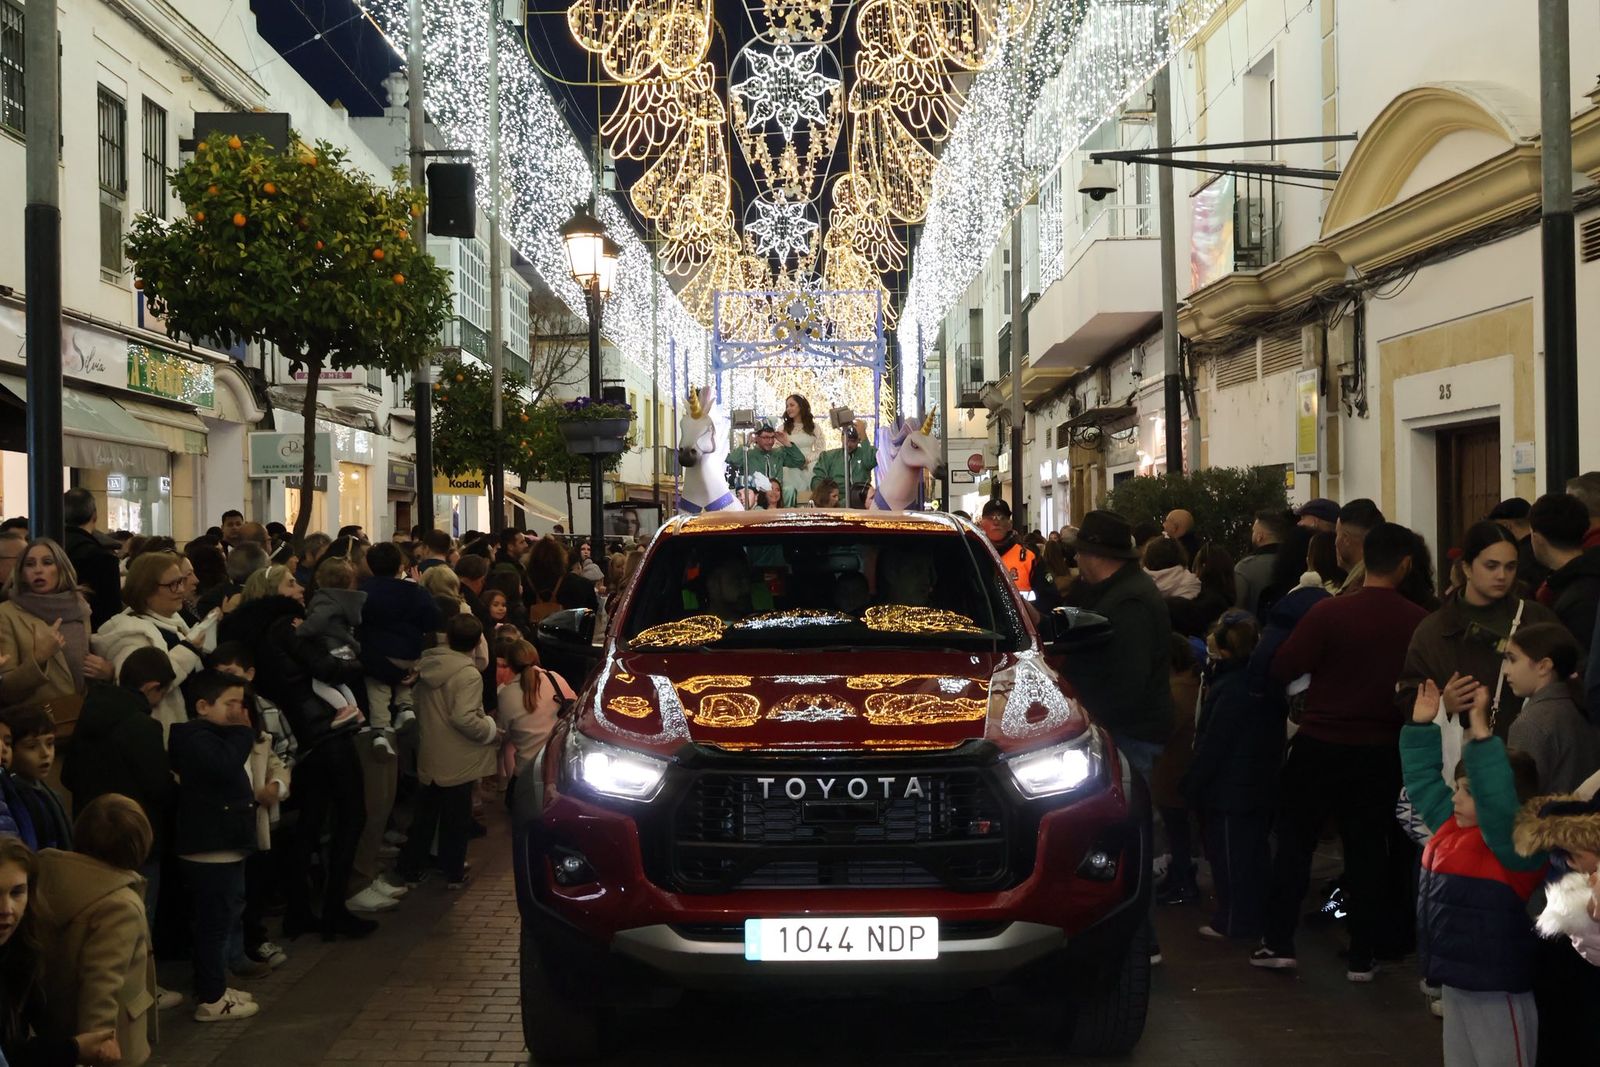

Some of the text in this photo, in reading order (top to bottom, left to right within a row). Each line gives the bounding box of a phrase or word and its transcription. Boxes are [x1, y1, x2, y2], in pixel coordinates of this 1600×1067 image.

[72, 331, 106, 374] Silvia
[449, 480, 481, 488] Kodak
[757, 776, 925, 801] TOYOTA
[779, 924, 926, 954] 1044 NDP
